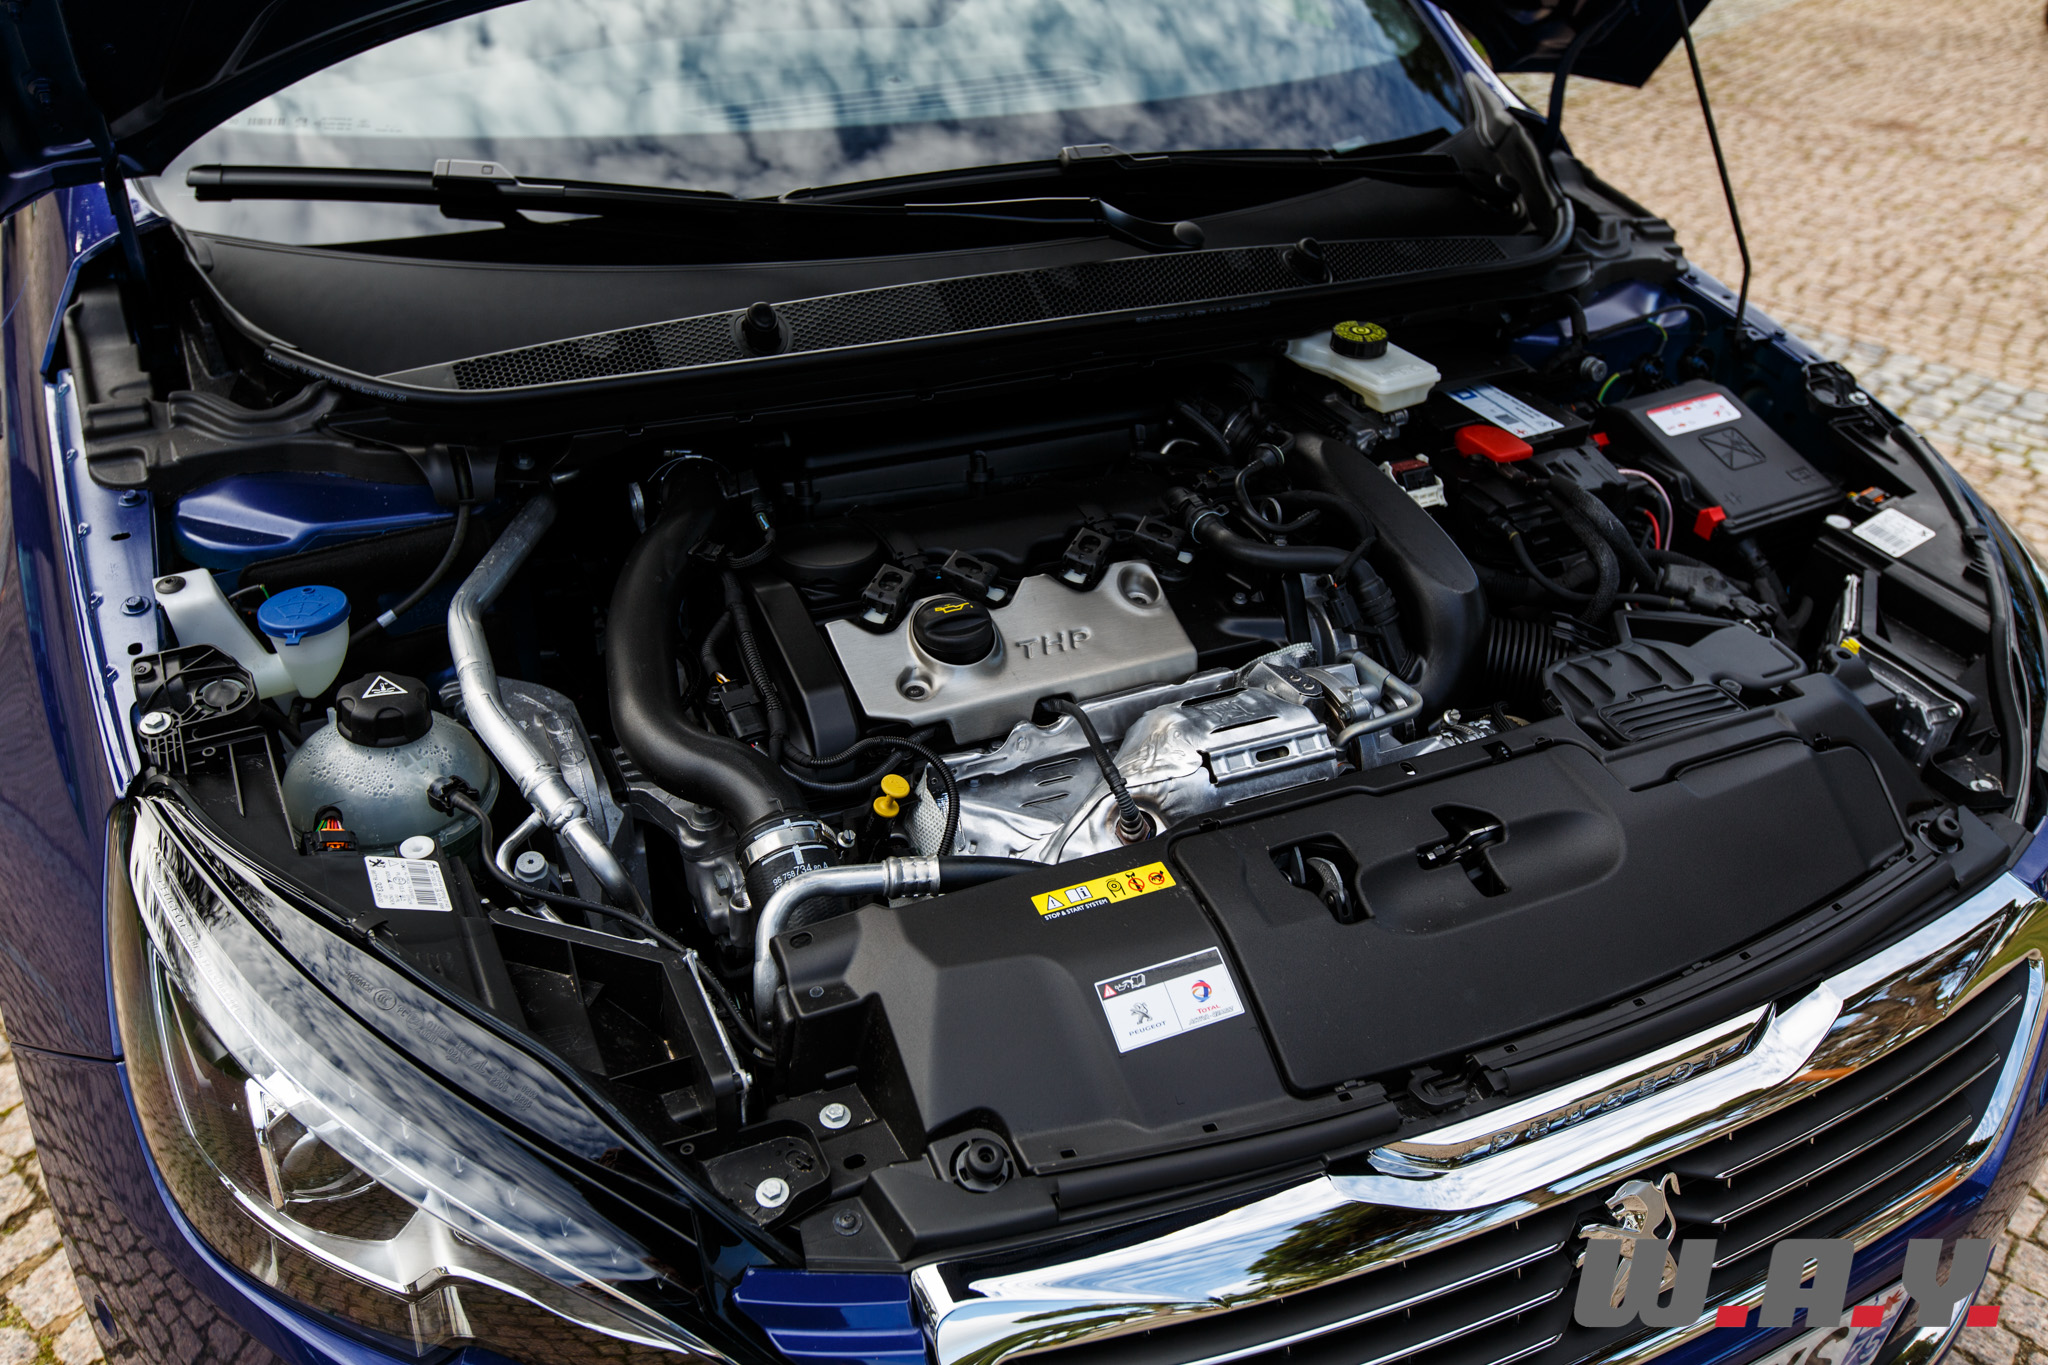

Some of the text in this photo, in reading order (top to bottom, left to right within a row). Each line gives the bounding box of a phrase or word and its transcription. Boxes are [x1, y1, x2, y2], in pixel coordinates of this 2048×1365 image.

[1015, 626, 1091, 659] THP
[1045, 911, 1060, 920] STOP
[1066, 905, 1084, 914] START
[1085, 899, 1108, 909] SYSTEM
[1197, 1005, 1220, 1014] TOTAL
[1129, 1021, 1166, 1036] PEUGEOT
[1489, 1048, 1723, 1155] PEUGEOT
